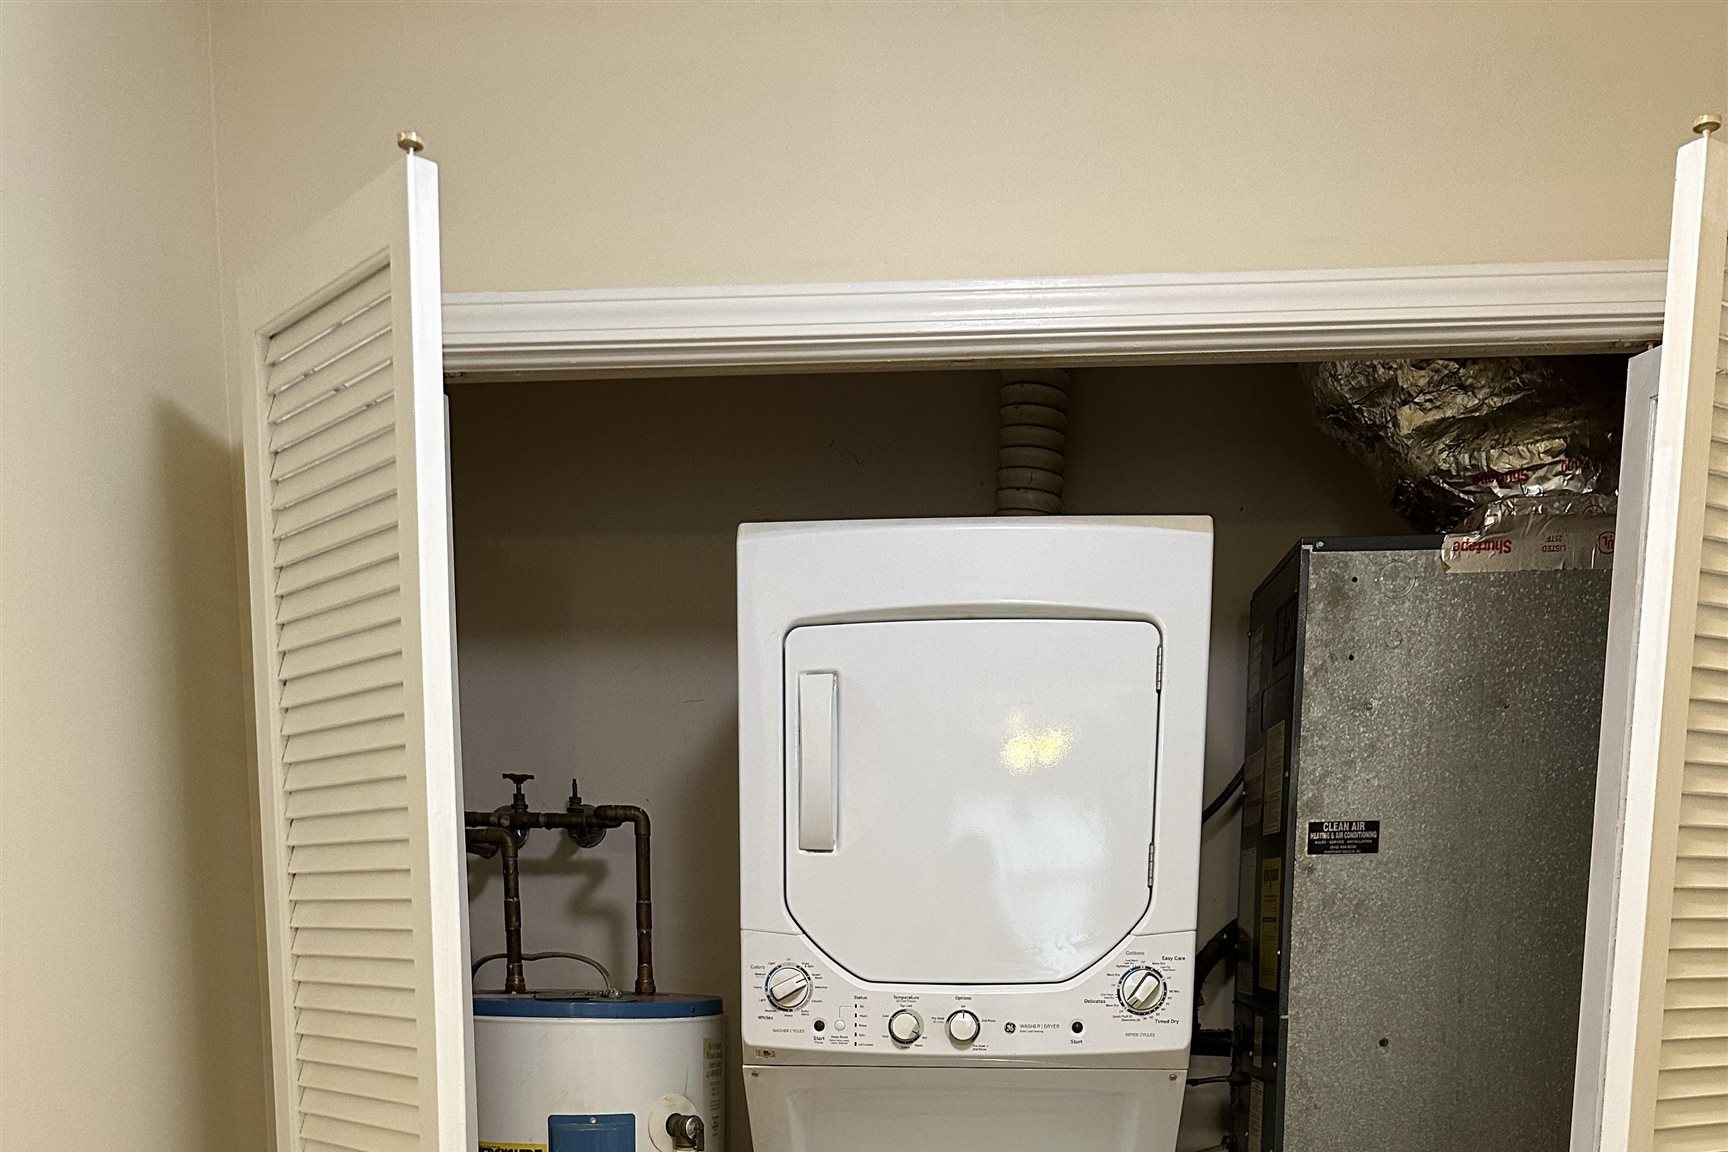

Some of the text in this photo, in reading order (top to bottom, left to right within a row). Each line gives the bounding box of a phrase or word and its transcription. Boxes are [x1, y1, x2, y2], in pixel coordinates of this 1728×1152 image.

[1453, 540, 1512, 554] Shurtape
[1323, 822, 1365, 831] CLEAN AIR
